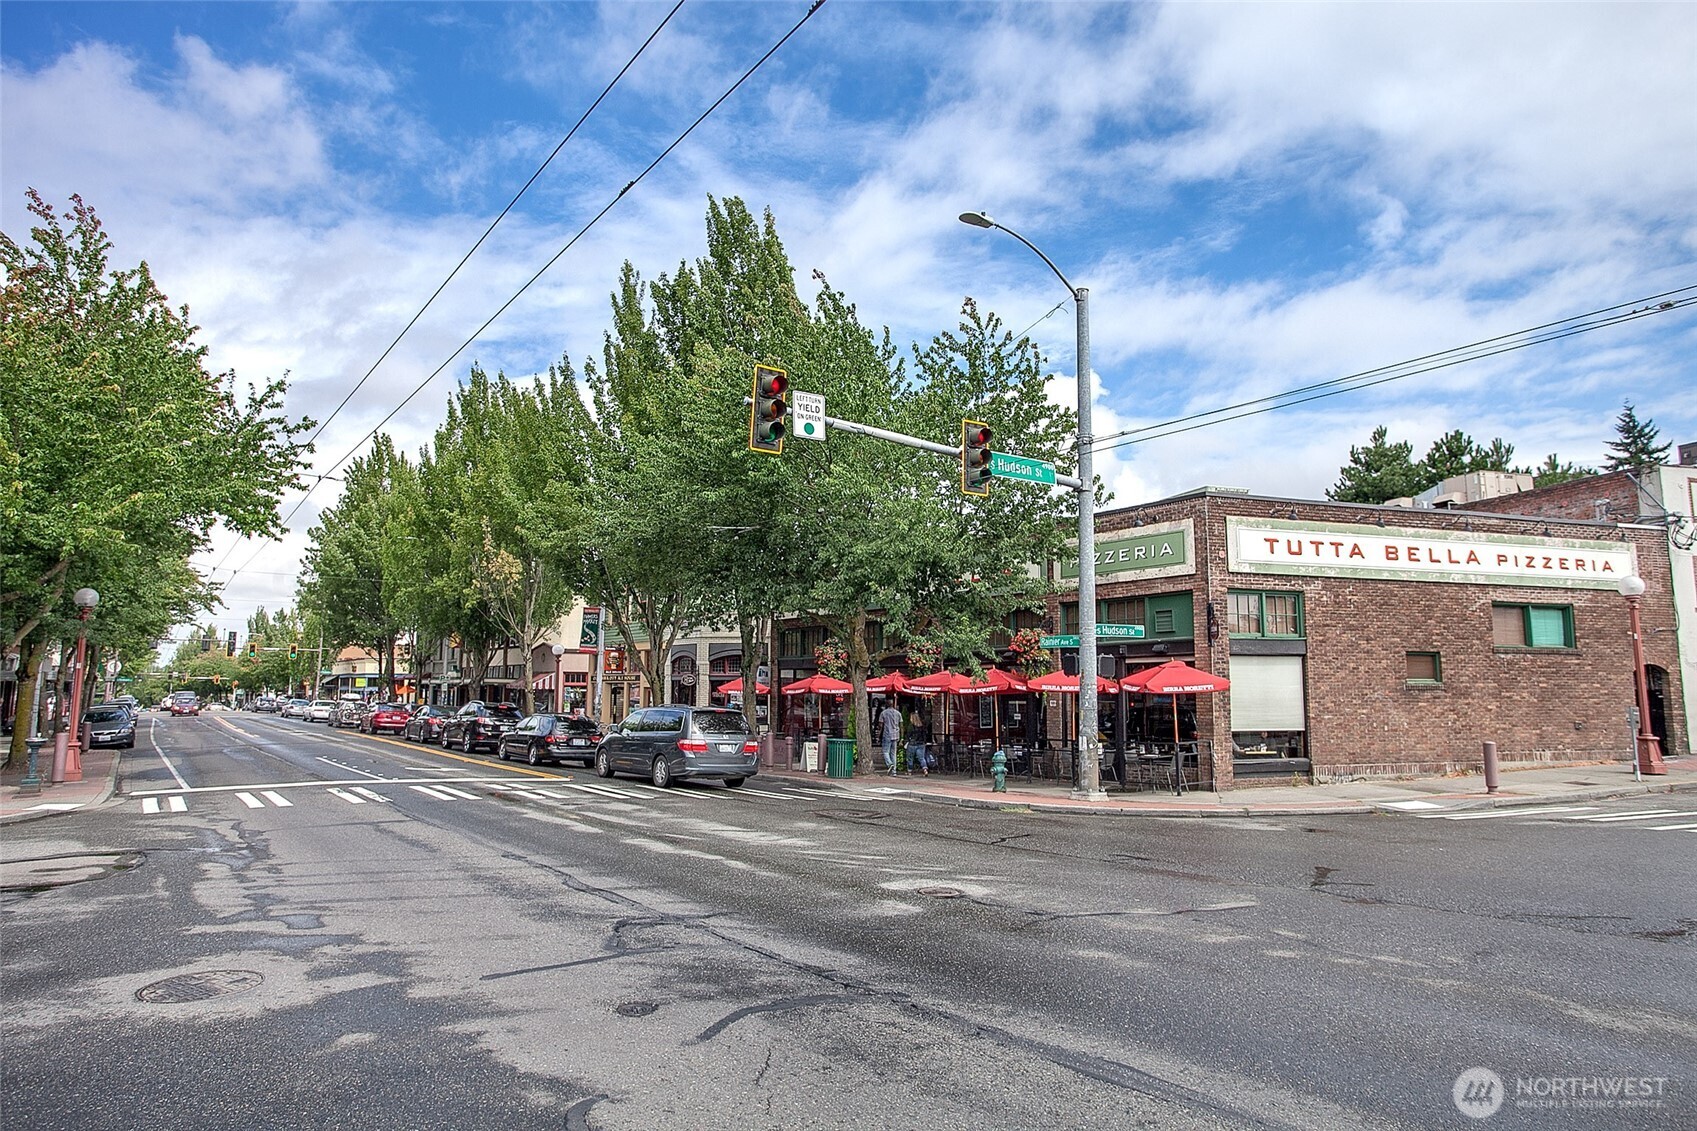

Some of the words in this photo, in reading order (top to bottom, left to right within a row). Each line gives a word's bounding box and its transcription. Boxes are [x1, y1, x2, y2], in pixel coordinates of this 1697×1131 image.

[797, 402, 821, 414] YIELD
[805, 414, 821, 422] GREEN
[997, 458, 1033, 476] Hudson
[1035, 467, 1043, 478] St
[1264, 537, 1366, 560] TUTTA
[1384, 544, 1482, 566] BELLA
[1496, 553, 1614, 573] PIZZERIA
[1102, 625, 1128, 635] Hudson
[1040, 636, 1060, 646] Rainier
[1069, 637, 1074, 645] S
